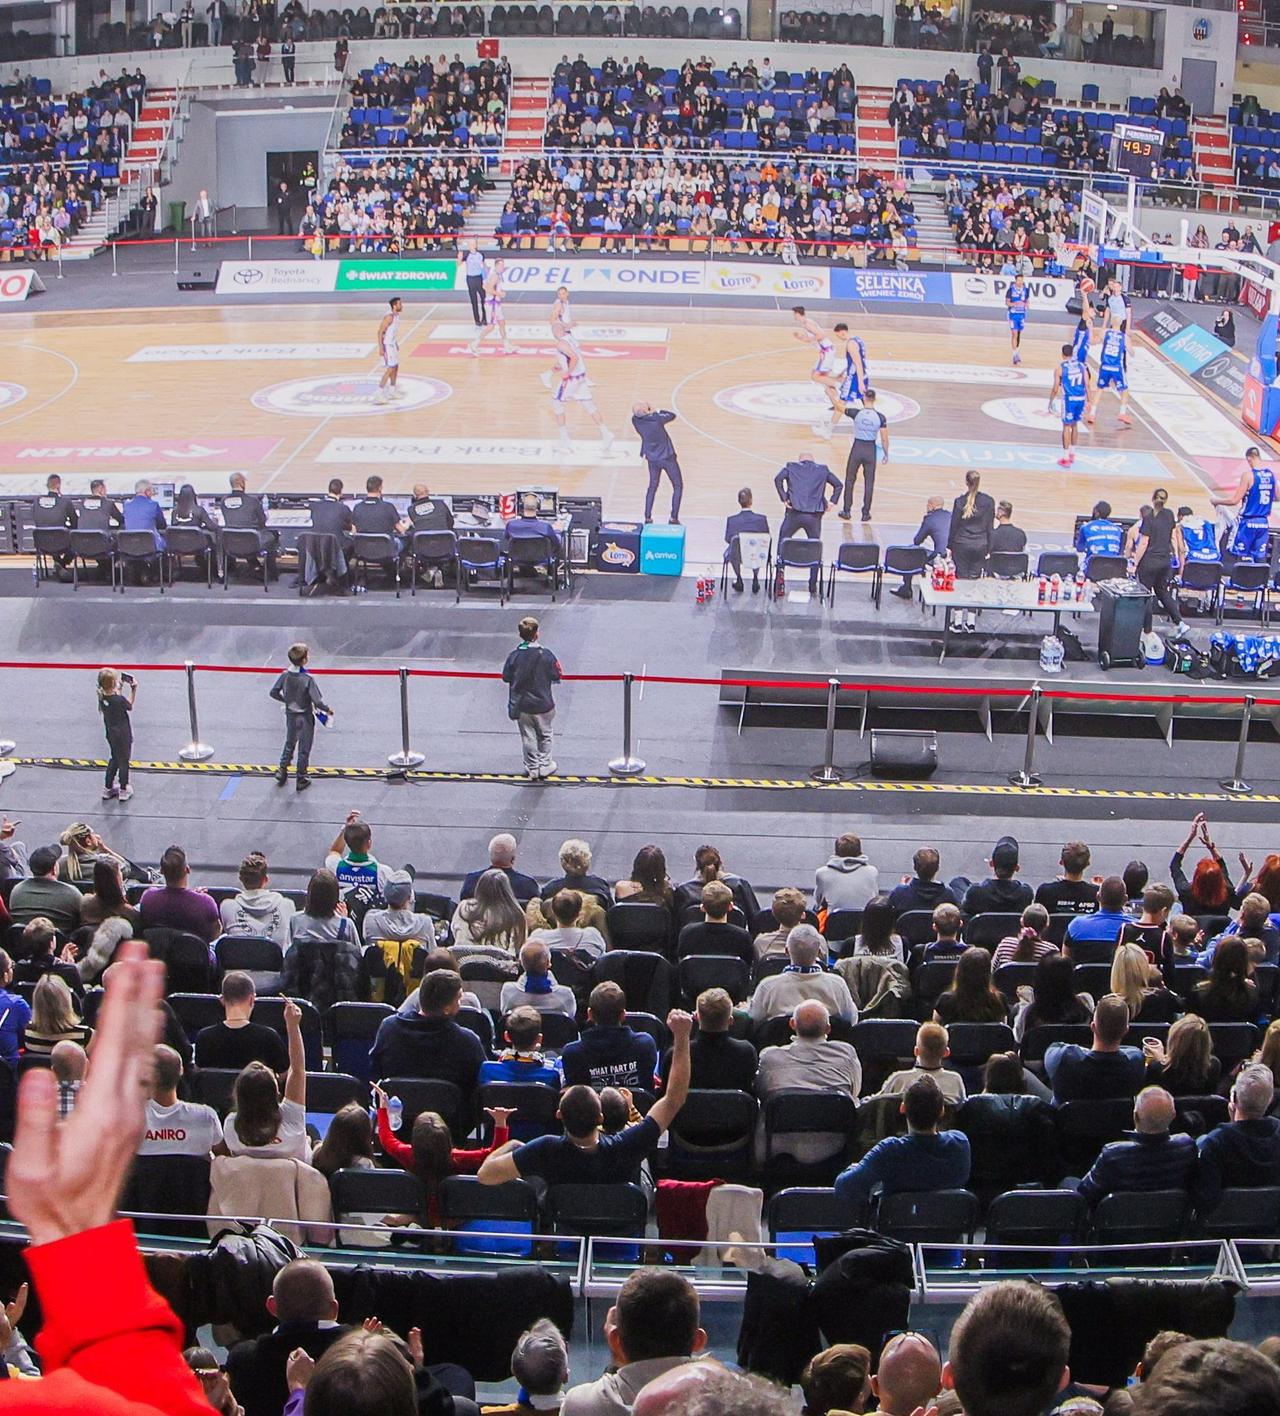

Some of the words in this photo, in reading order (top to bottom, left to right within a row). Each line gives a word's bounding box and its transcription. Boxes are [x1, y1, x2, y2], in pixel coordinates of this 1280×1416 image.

[1123, 141, 1152, 156] 49.3
[273, 268, 307, 277] Toyota
[358, 269, 393, 281] ŚWIAT
[395, 270, 448, 281] ZDROWIA
[619, 269, 701, 284] ONDE
[856, 275, 926, 294] SELENKA
[993, 280, 1057, 299] PWO
[860, 290, 896, 298] WIENIEC
[1070, 373, 1083, 387] 77
[18, 447, 153, 460] ORLEN
[654, 551, 677, 560] arriva
[338, 873, 375, 884] anvistar
[589, 1066, 608, 1076] WHAT
[609, 1063, 628, 1074] PART
[628, 1061, 637, 1071] OF
[144, 1128, 187, 1141] ANIRO
